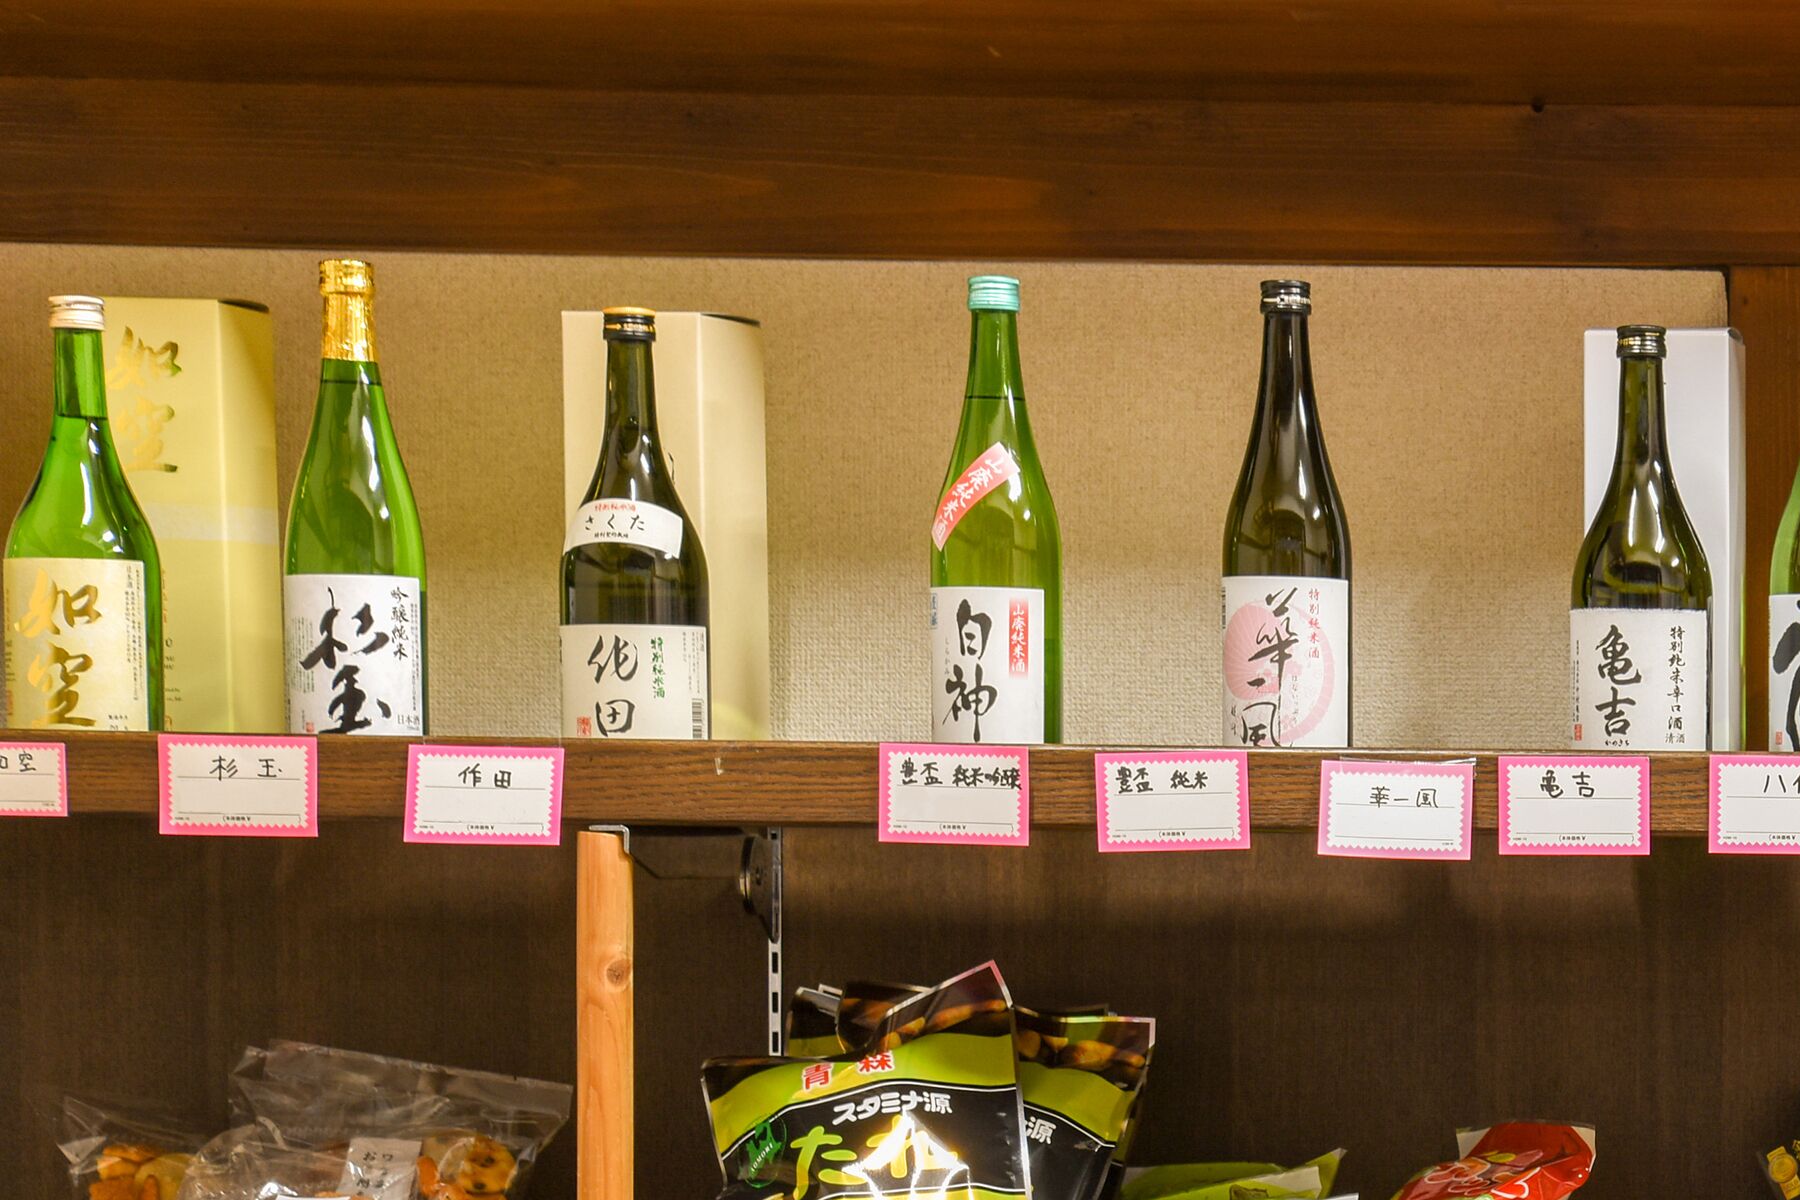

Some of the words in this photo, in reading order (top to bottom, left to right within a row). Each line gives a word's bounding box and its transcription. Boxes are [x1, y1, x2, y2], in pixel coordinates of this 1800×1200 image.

[584, 513, 646, 532] さくた
[942, 598, 998, 743] 白神
[1594, 624, 1642, 738] 亀吉
[801, 1050, 895, 1091] 青森
[832, 1091, 952, 1127] スタミナ源
